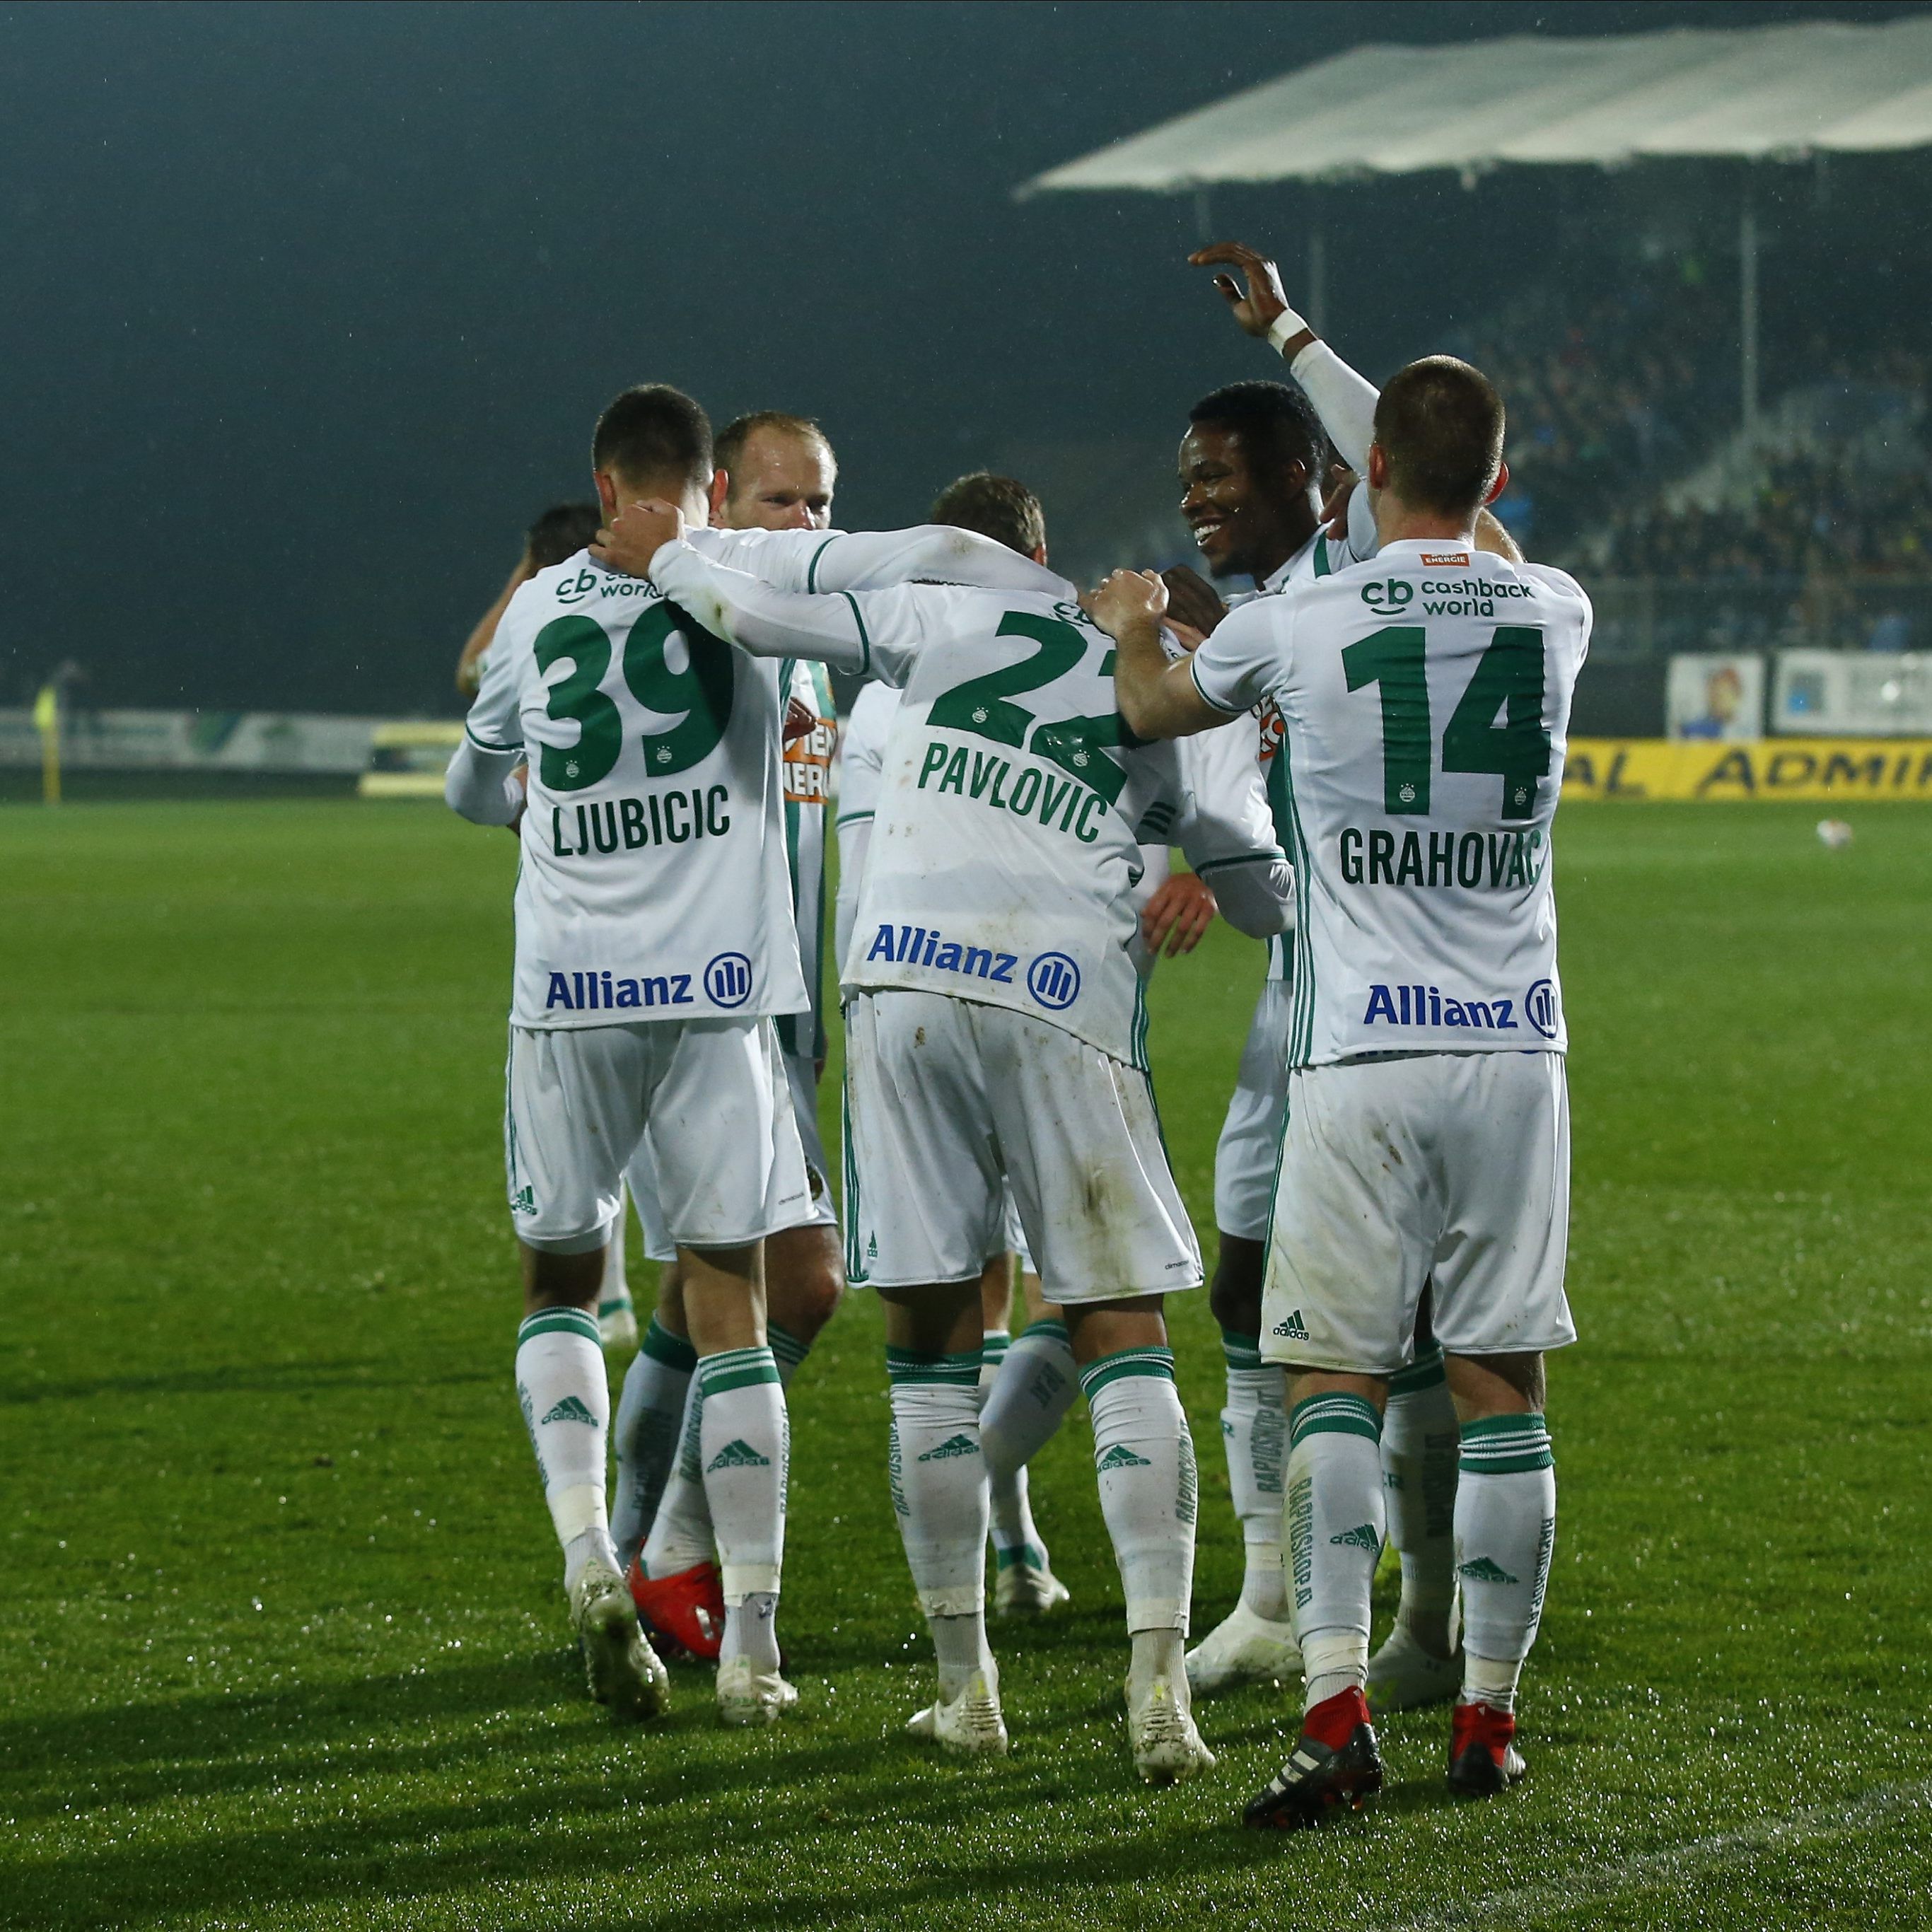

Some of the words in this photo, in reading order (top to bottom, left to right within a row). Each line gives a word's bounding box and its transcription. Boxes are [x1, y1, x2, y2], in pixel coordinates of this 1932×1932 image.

[556, 569, 597, 595] cb
[1361, 578, 1414, 605] cb
[1421, 578, 1535, 598] cashback
[1422, 598, 1494, 617] world
[533, 598, 734, 791] 39
[1341, 626, 1552, 820] 14
[917, 743, 1107, 843] PAVLOVIC
[552, 784, 730, 856] LJUBICIC
[1340, 827, 1542, 888] GRAHOVAC
[866, 924, 1018, 984] Allianz
[546, 971, 694, 1009] Allianz
[1363, 985, 1518, 1028] Allianz
[1273, 1326, 1309, 1341] adidas
[542, 1407, 598, 1427] adidas
[707, 1455, 770, 1474] adidas
[1289, 1476, 1313, 1610] RAPIDSHOP.AT
